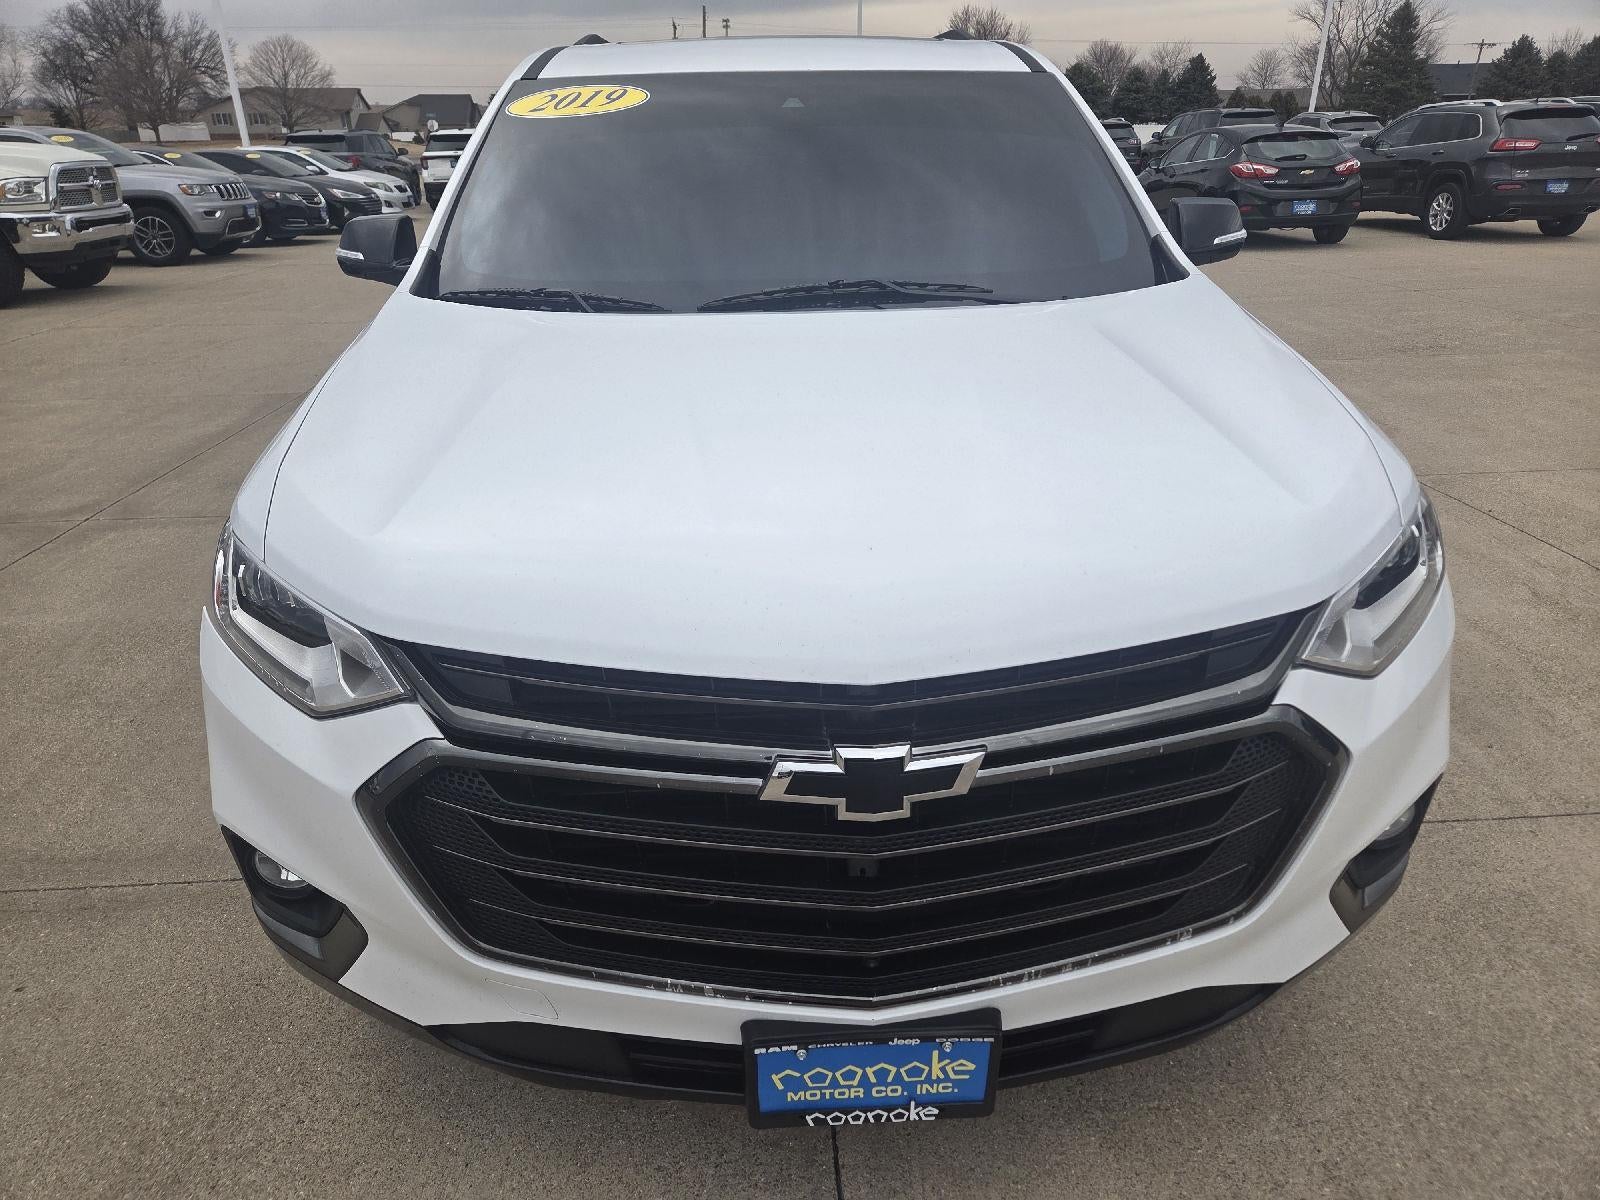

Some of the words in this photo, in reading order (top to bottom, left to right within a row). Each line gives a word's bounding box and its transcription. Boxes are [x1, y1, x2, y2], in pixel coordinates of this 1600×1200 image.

[528, 88, 628, 113] 2019
[754, 1045, 798, 1055] RAM
[888, 1037, 921, 1046] Jeep
[786, 1087, 864, 1102] MOTOR
[871, 1085, 908, 1099] CO.
[916, 1082, 959, 1095] INC.
